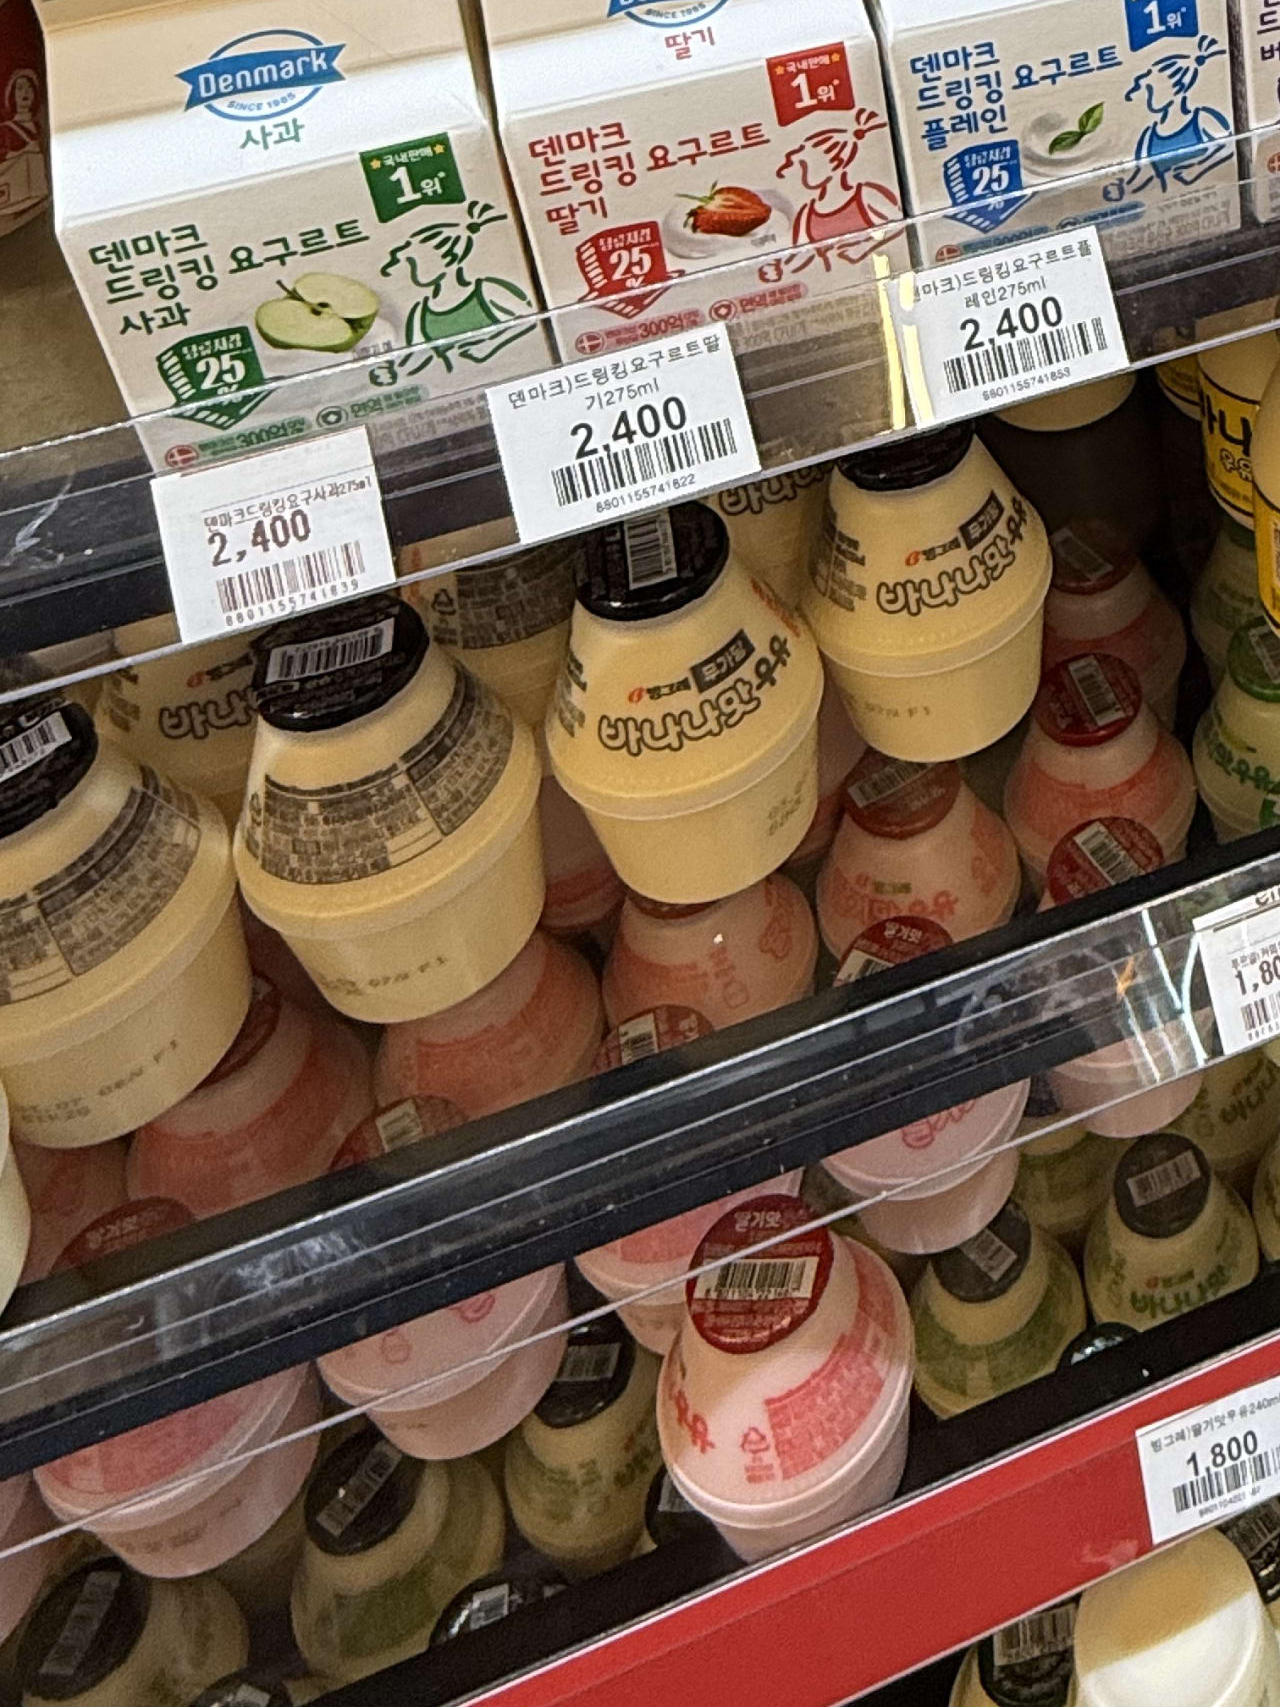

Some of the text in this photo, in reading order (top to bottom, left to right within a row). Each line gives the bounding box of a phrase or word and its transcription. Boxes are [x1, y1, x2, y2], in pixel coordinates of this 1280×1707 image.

[665, 27, 716, 60] 딸기
[909, 42, 1000, 84] 덴마크
[199, 49, 328, 98] Denmark
[917, 45, 1123, 111] 드링킹 요구르트
[239, 118, 305, 151] 사과
[529, 122, 630, 167] 덴마크
[922, 106, 1009, 151] 플레인
[540, 123, 771, 197] 드링킹 요구르트
[546, 197, 608, 236] 딸기
[89, 224, 207, 269] 덴마크
[105, 219, 370, 304] 드링킹 요구르트
[965, 276, 1046, 309] 레인275ml
[119, 303, 192, 336] 사과
[960, 296, 1063, 352] 2,400
[508, 335, 719, 408] 덴마크)드링킹요구르트딸
[585, 380, 659, 411] 기275ml
[571, 397, 688, 461] 2,400
[209, 511, 310, 568] 2,400
[877, 495, 1029, 616] 바나나맛우유
[598, 633, 793, 756] 바나나맛우유
[1186, 1430, 1259, 1482] 1,800
